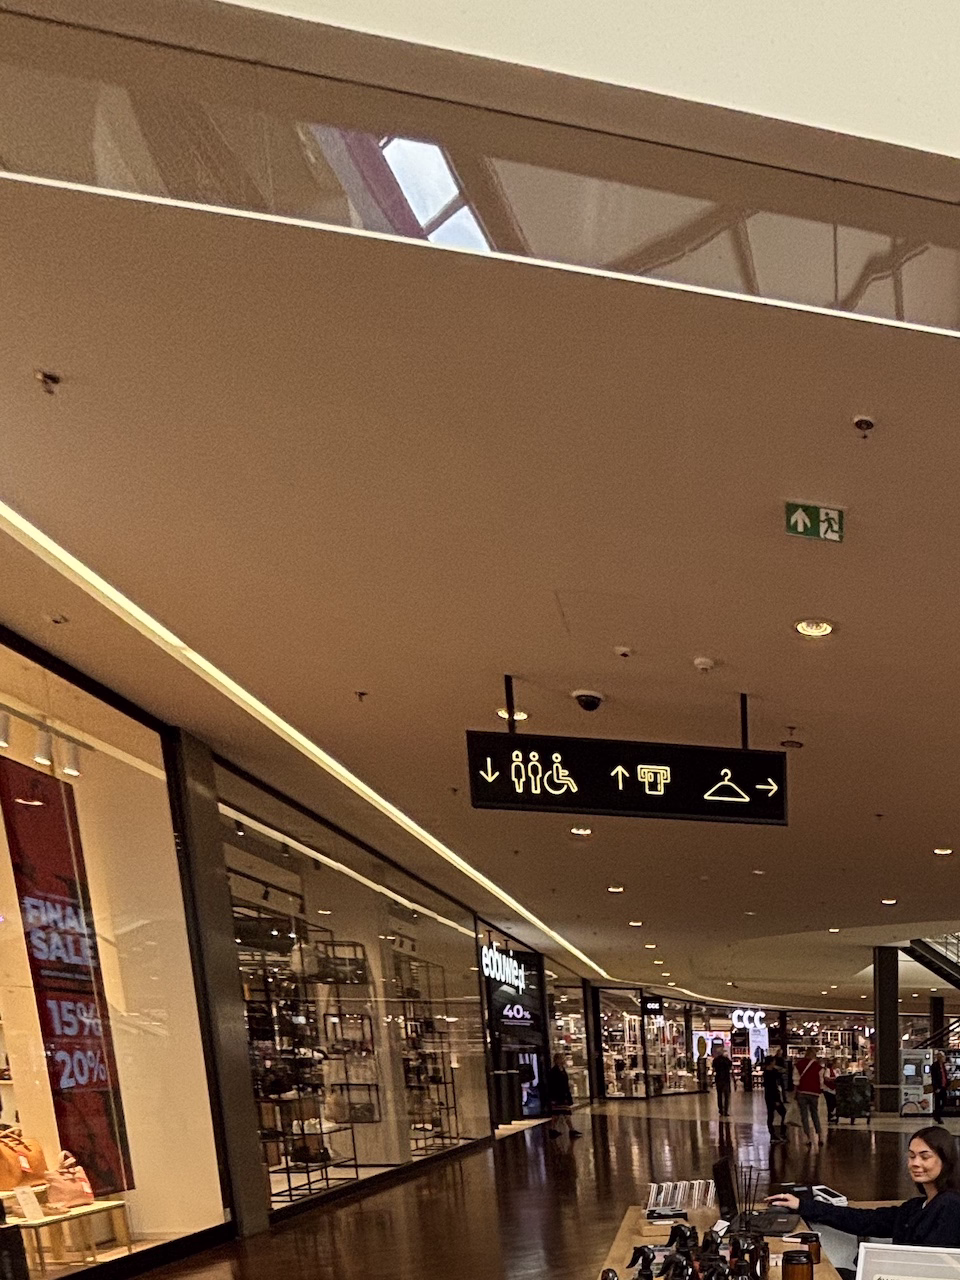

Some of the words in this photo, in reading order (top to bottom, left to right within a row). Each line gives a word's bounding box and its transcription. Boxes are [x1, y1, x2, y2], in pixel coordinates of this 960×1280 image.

[23, 897, 93, 935] FINAL
[29, 927, 97, 967] SALE
[46, 1000, 103, 1036] 15%
[502, 1004, 532, 1019] 40%
[731, 1009, 766, 1029] CCC
[55, 1051, 108, 1089] 20%
